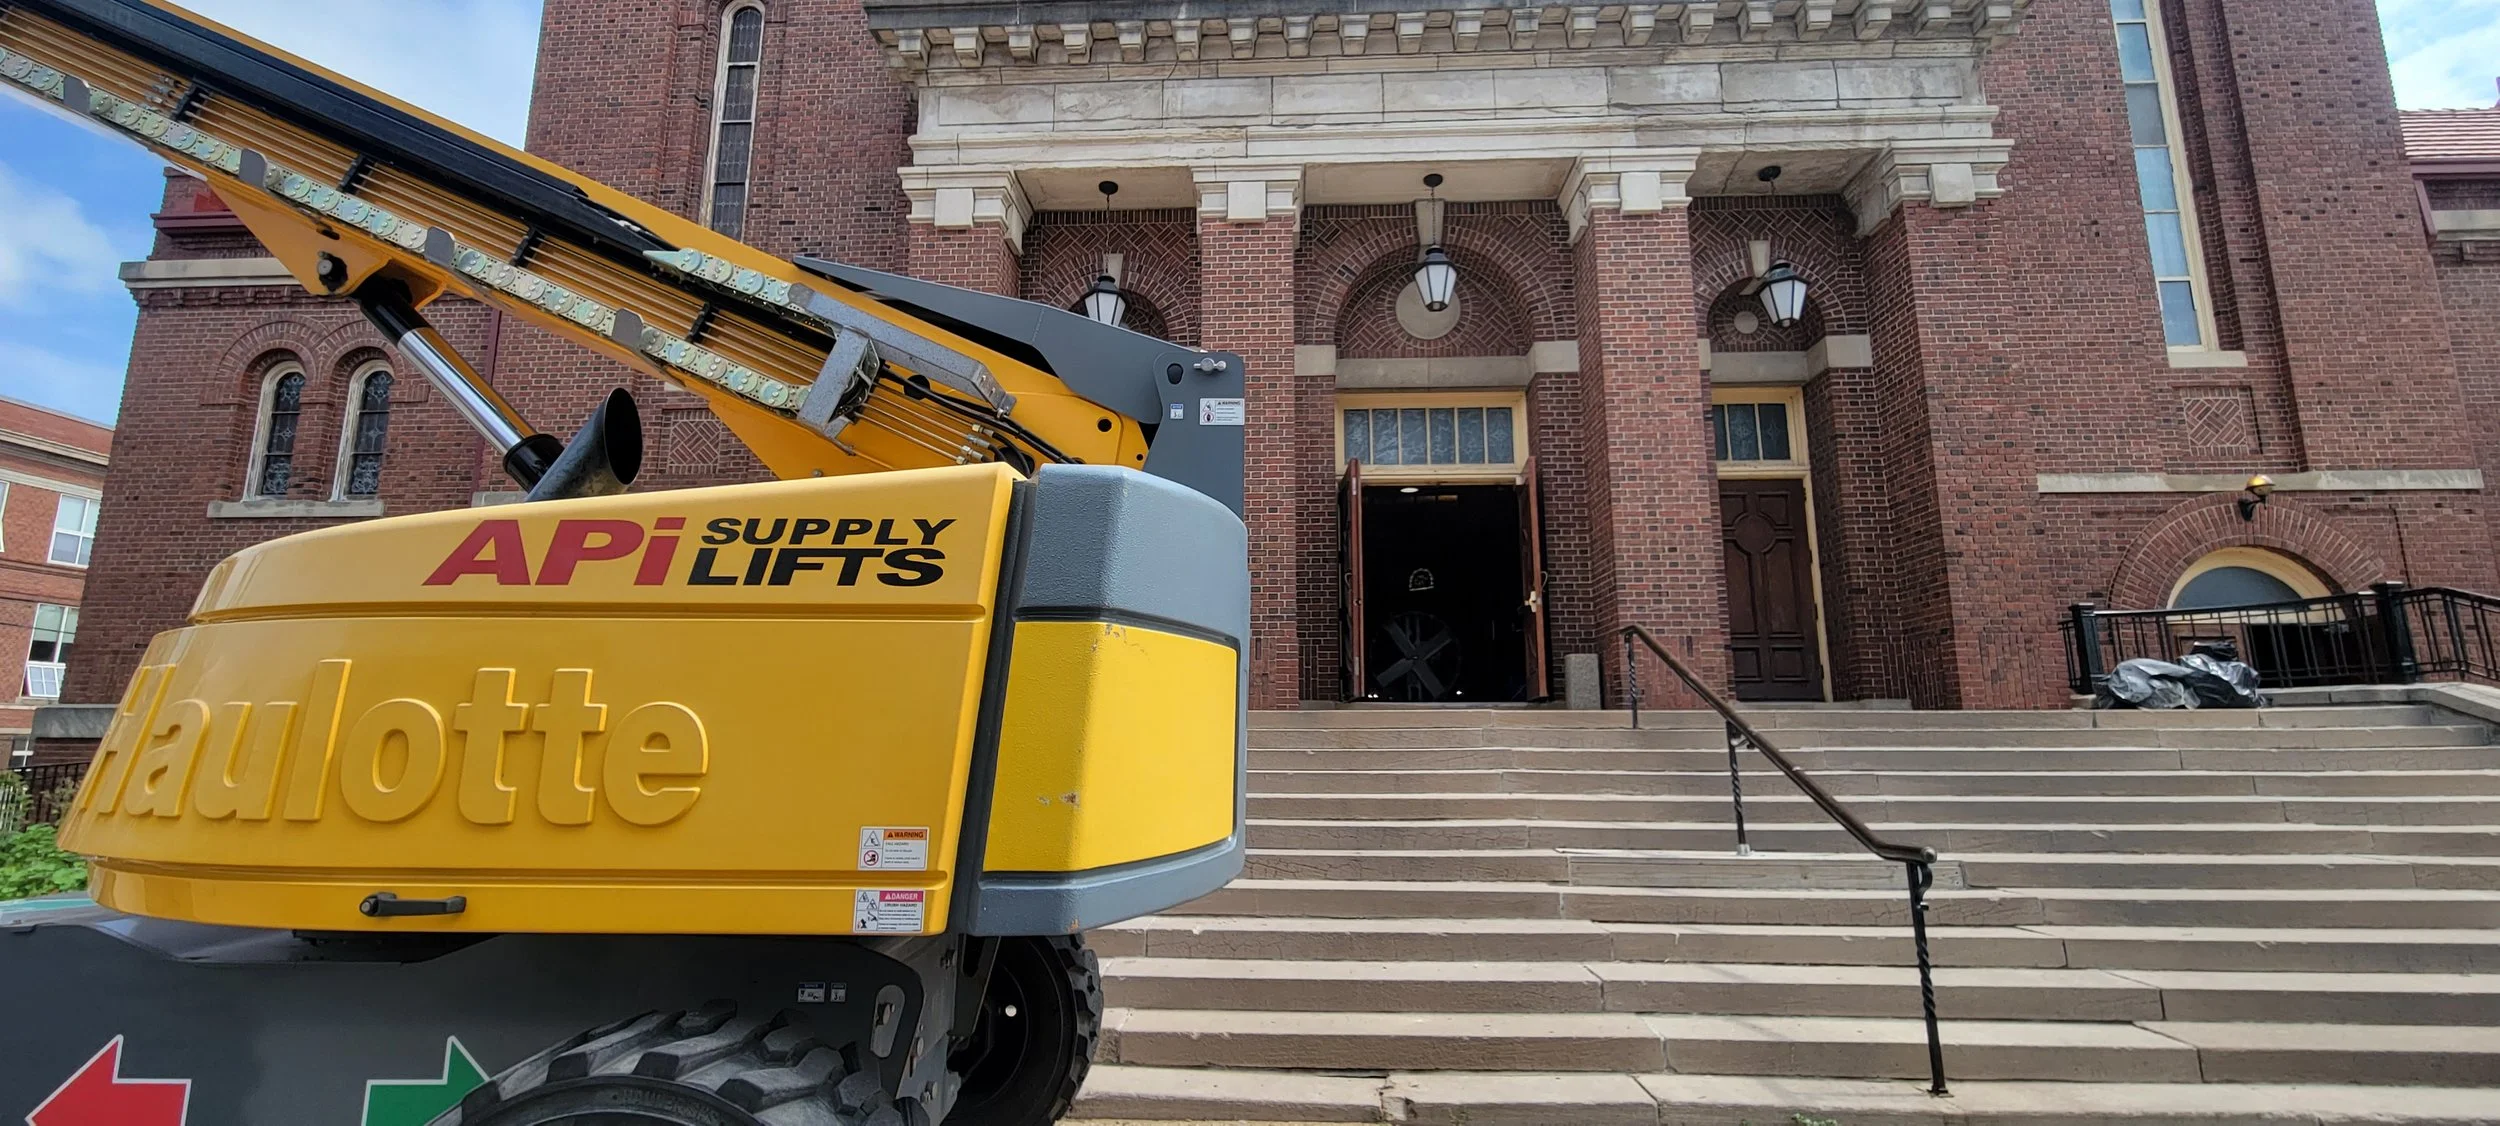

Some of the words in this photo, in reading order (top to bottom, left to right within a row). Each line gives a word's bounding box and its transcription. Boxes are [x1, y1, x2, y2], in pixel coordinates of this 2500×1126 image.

[701, 517, 957, 546] SUPPLY
[421, 516, 687, 586] APi
[686, 546, 947, 588] LIFTS
[68, 658, 709, 826] Haulotte
[894, 831, 924, 839] WARNING
[891, 892, 918, 901] DANGER
